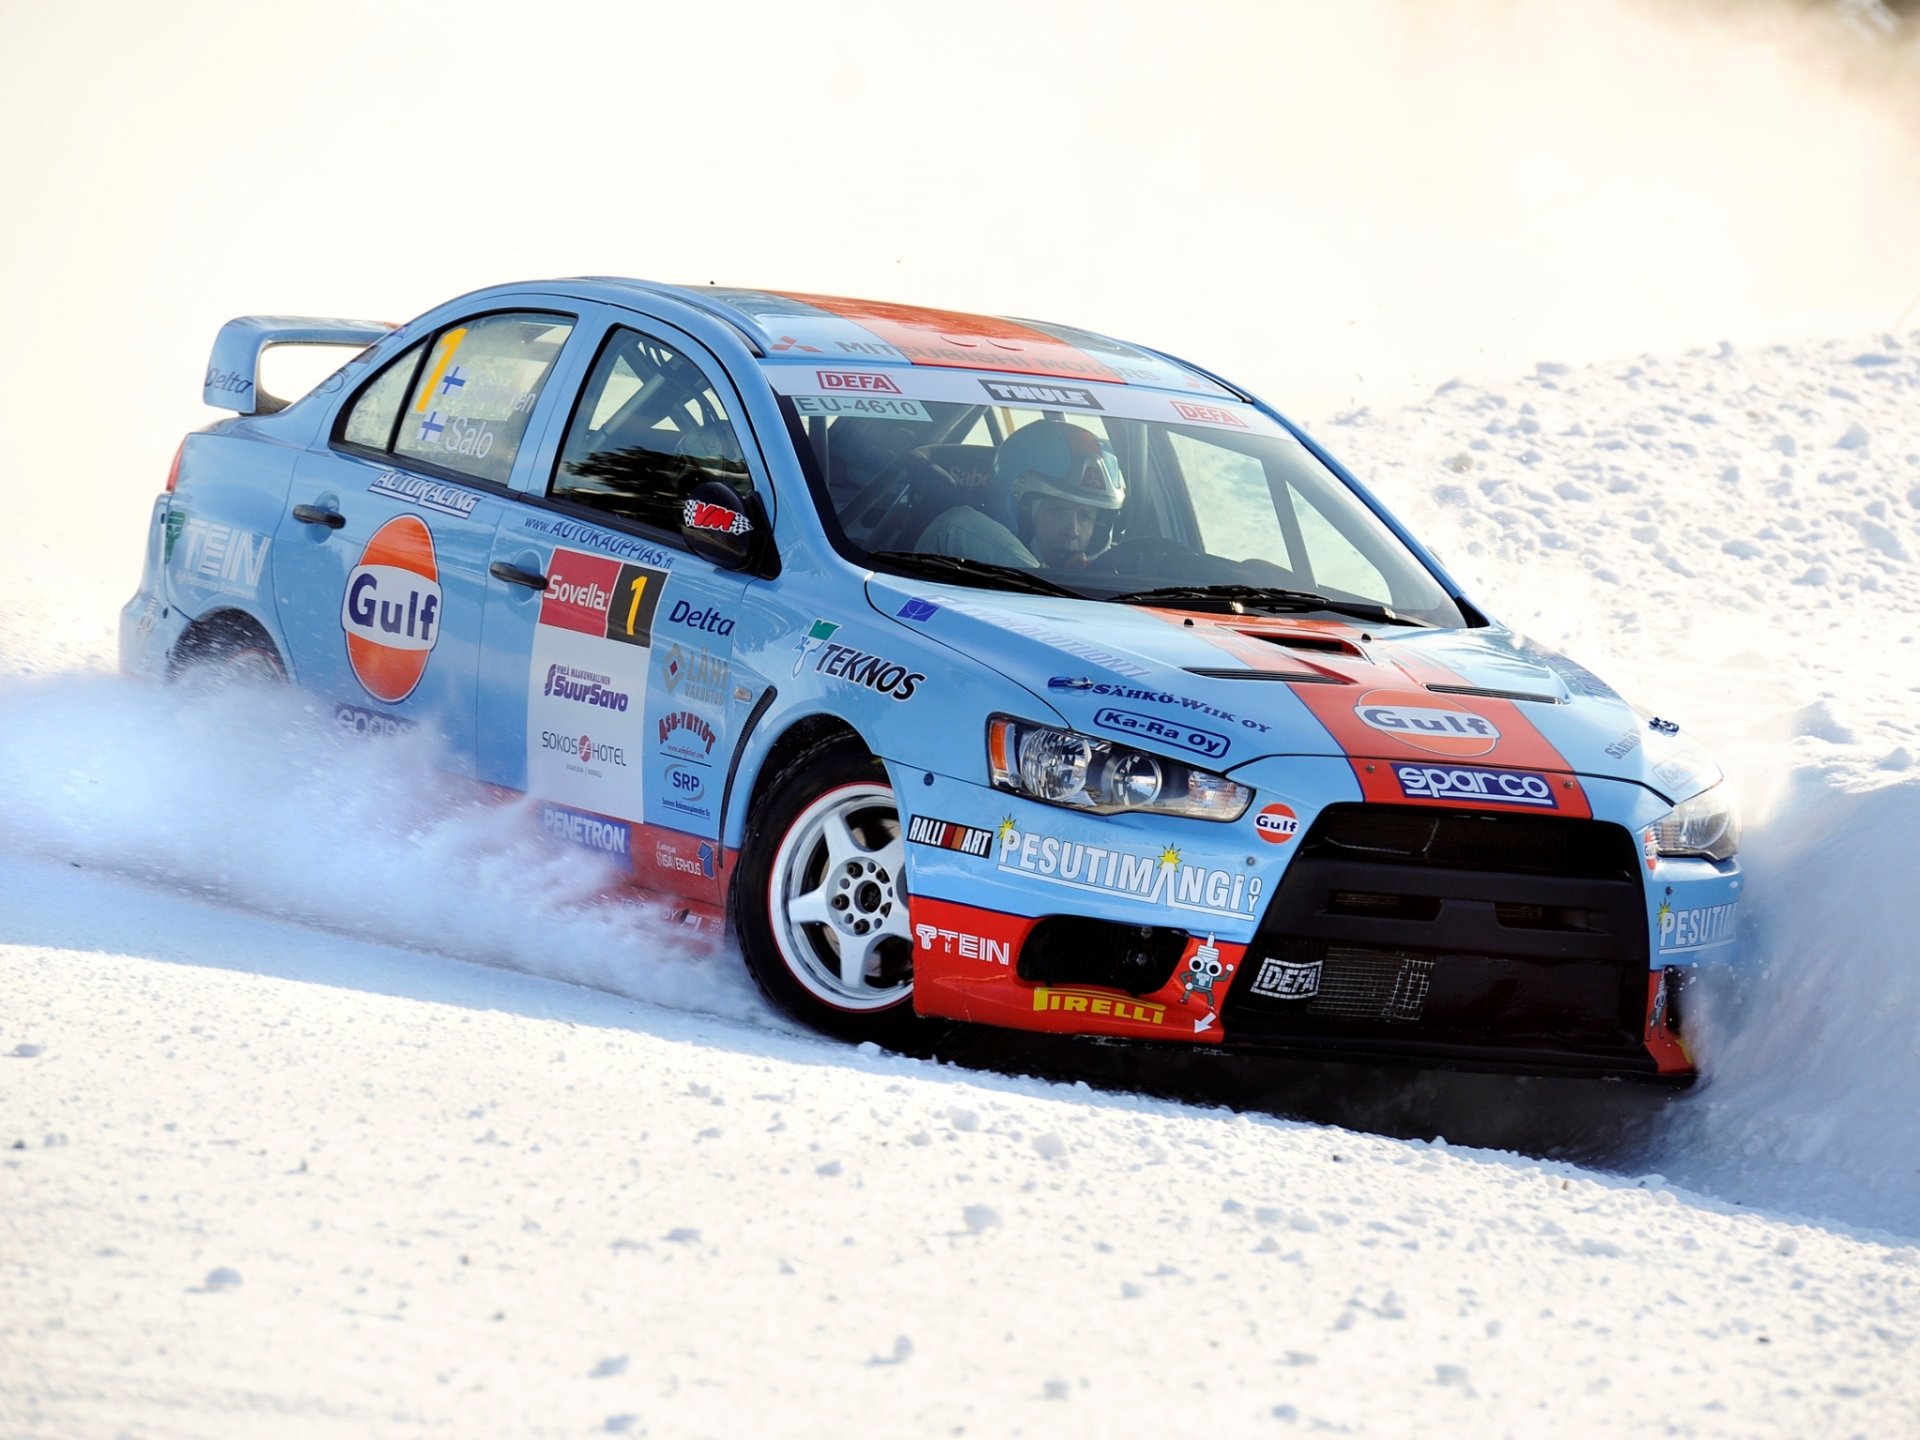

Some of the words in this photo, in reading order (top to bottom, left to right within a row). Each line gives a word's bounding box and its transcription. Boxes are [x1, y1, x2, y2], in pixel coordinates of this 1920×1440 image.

[205, 367, 253, 395] Delta
[415, 327, 469, 413] 1
[824, 374, 891, 391] DEFA
[795, 397, 919, 417] EU-4610
[987, 383, 1091, 406] THULE
[1178, 405, 1239, 424] DEFA
[445, 415, 494, 460] Salo
[373, 470, 482, 513] AUTORACING
[183, 517, 273, 588] TEIN
[523, 515, 676, 570] www.AUTOKAUPPIAS.fi
[348, 572, 438, 641] Gulf
[543, 574, 607, 612] Sovella
[626, 575, 648, 637] 1
[668, 599, 736, 637] Delta
[815, 642, 926, 701] TEKNOS
[552, 674, 629, 712] SuurSavo
[1103, 711, 1180, 740] Ka-Ra
[1187, 733, 1221, 754] Oy
[1363, 708, 1489, 735] Gulf
[541, 730, 578, 756] SOKOS
[591, 743, 627, 767] HOTEL
[672, 770, 700, 792] SRP
[1398, 766, 1550, 799] sparco
[543, 808, 626, 854] PENETRON
[1255, 815, 1298, 833] Gulf
[938, 928, 1010, 966] TEIN
[1260, 964, 1318, 993] DEFA
[1032, 986, 1167, 1024] PIRELLI
